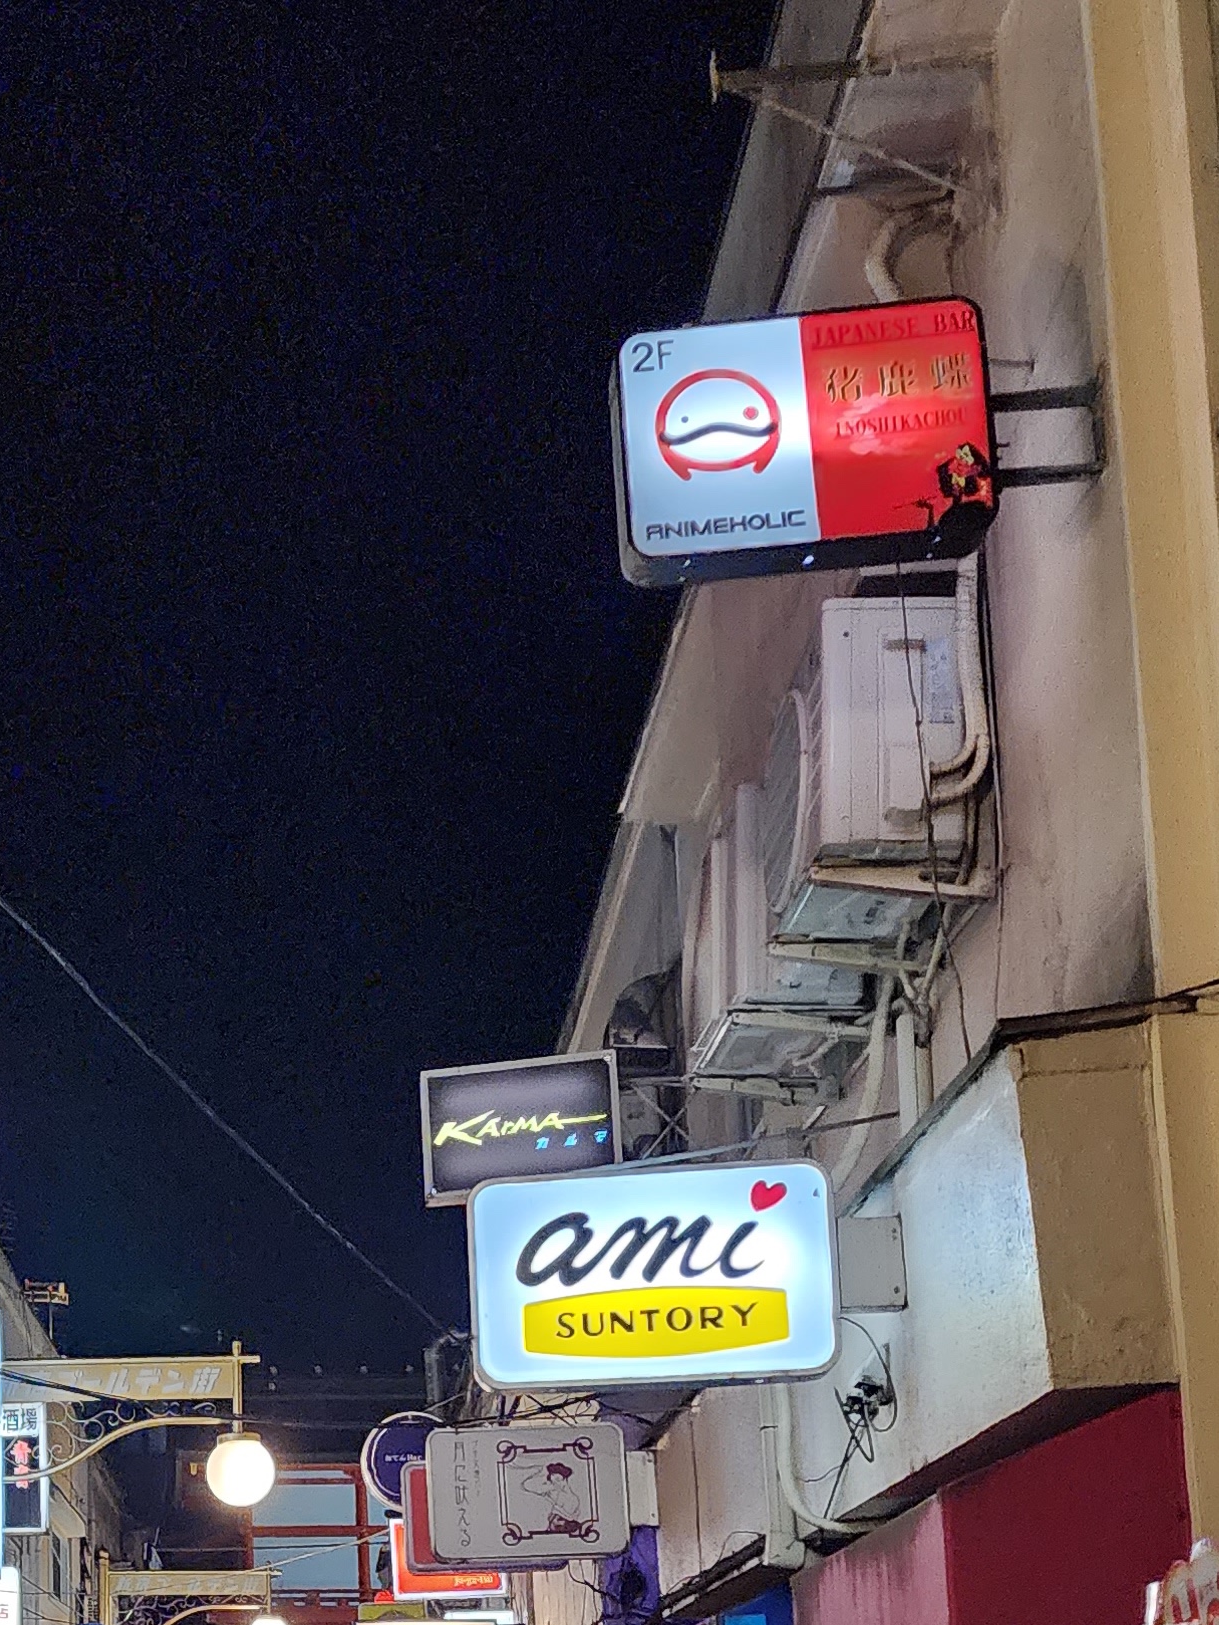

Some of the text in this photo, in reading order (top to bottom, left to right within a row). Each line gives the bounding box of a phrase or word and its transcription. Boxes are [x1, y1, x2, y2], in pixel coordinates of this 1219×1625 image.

[812, 309, 975, 345] JAPANESE BAR
[632, 340, 674, 374] 2F
[826, 352, 972, 403] 猪鹿蝶
[646, 510, 806, 542] ANIMEHOLIC
[516, 1195, 768, 1287] ami
[555, 1301, 759, 1339] SUNTORY
[3, 1407, 37, 1431] 酒場
[453, 1441, 472, 1548] 月に吠える
